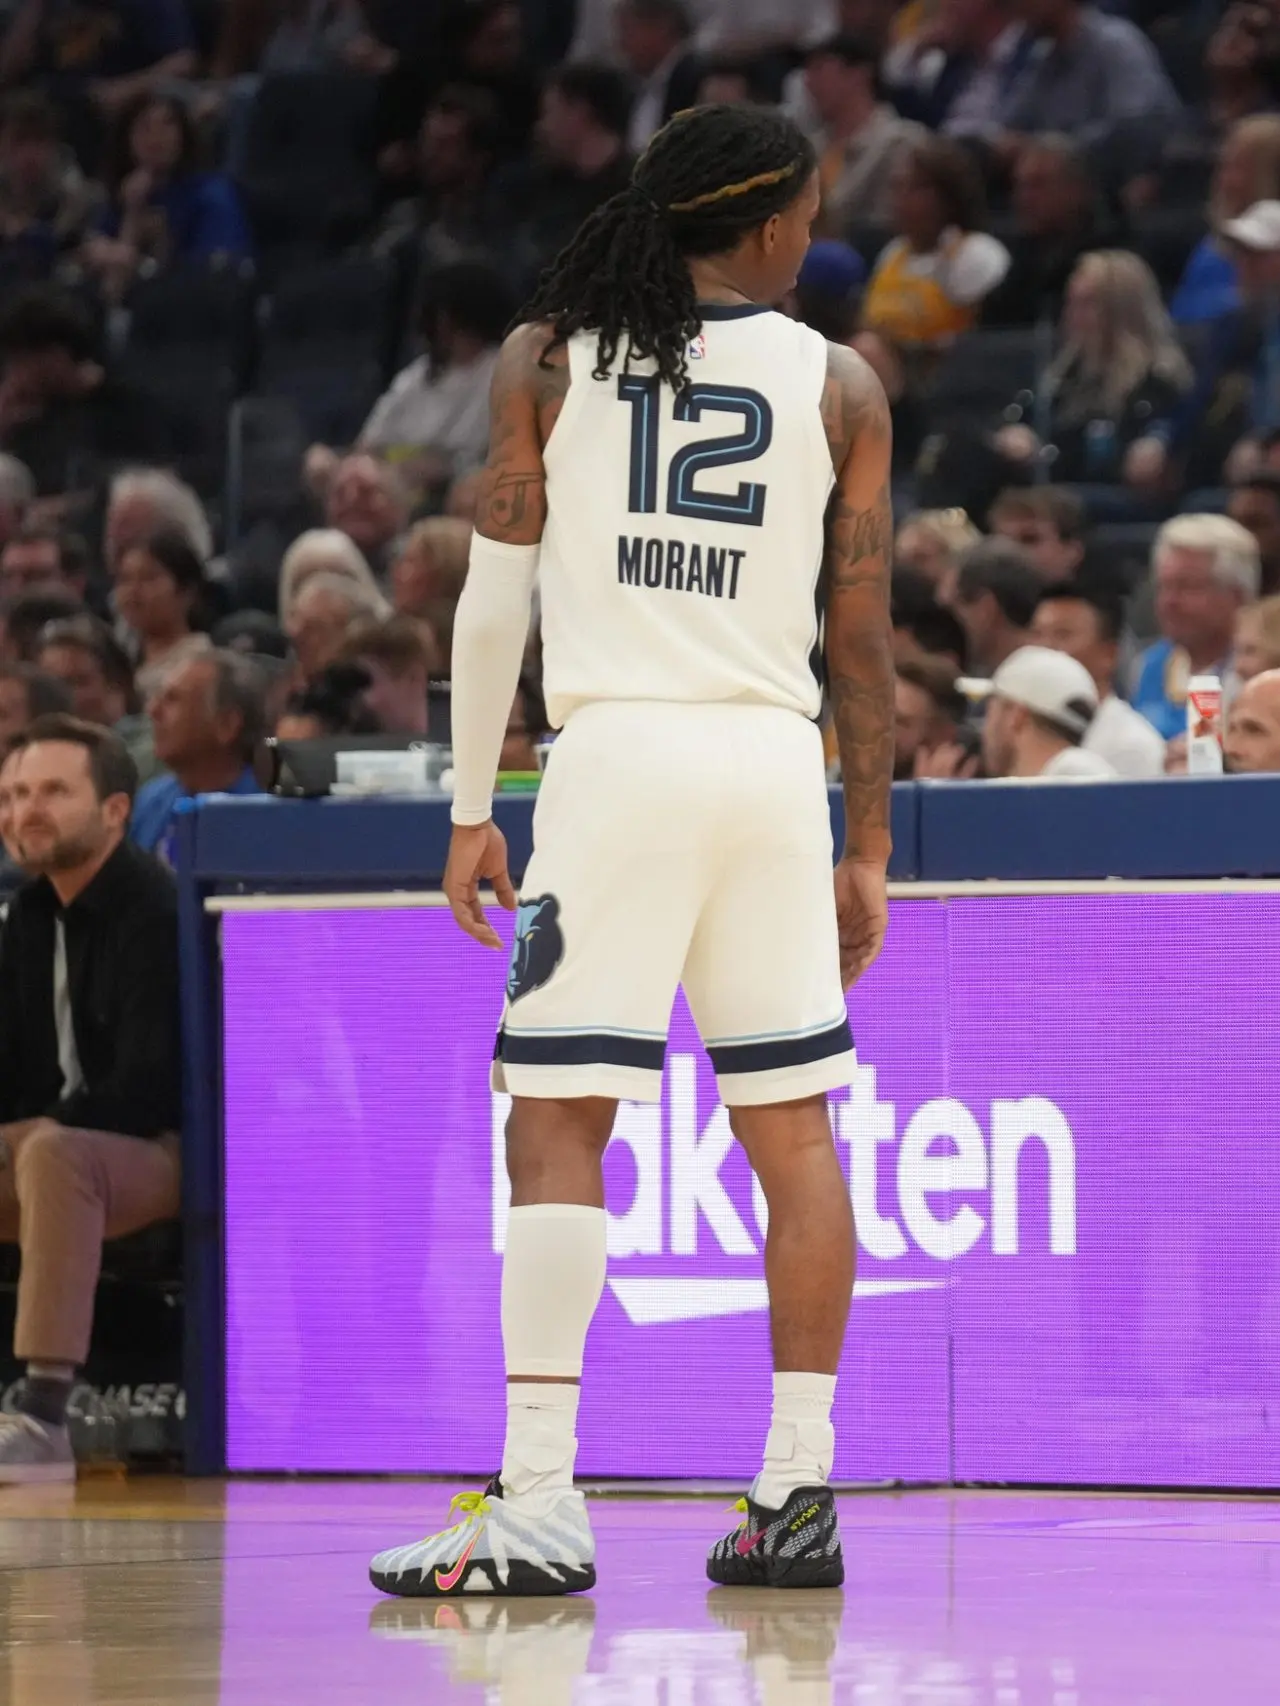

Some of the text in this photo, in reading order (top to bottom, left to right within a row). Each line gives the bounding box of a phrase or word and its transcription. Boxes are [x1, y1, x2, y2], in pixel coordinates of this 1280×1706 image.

[618, 374, 773, 527] 12
[617, 535, 746, 600] MORANT
[492, 1053, 1077, 1260] akten
